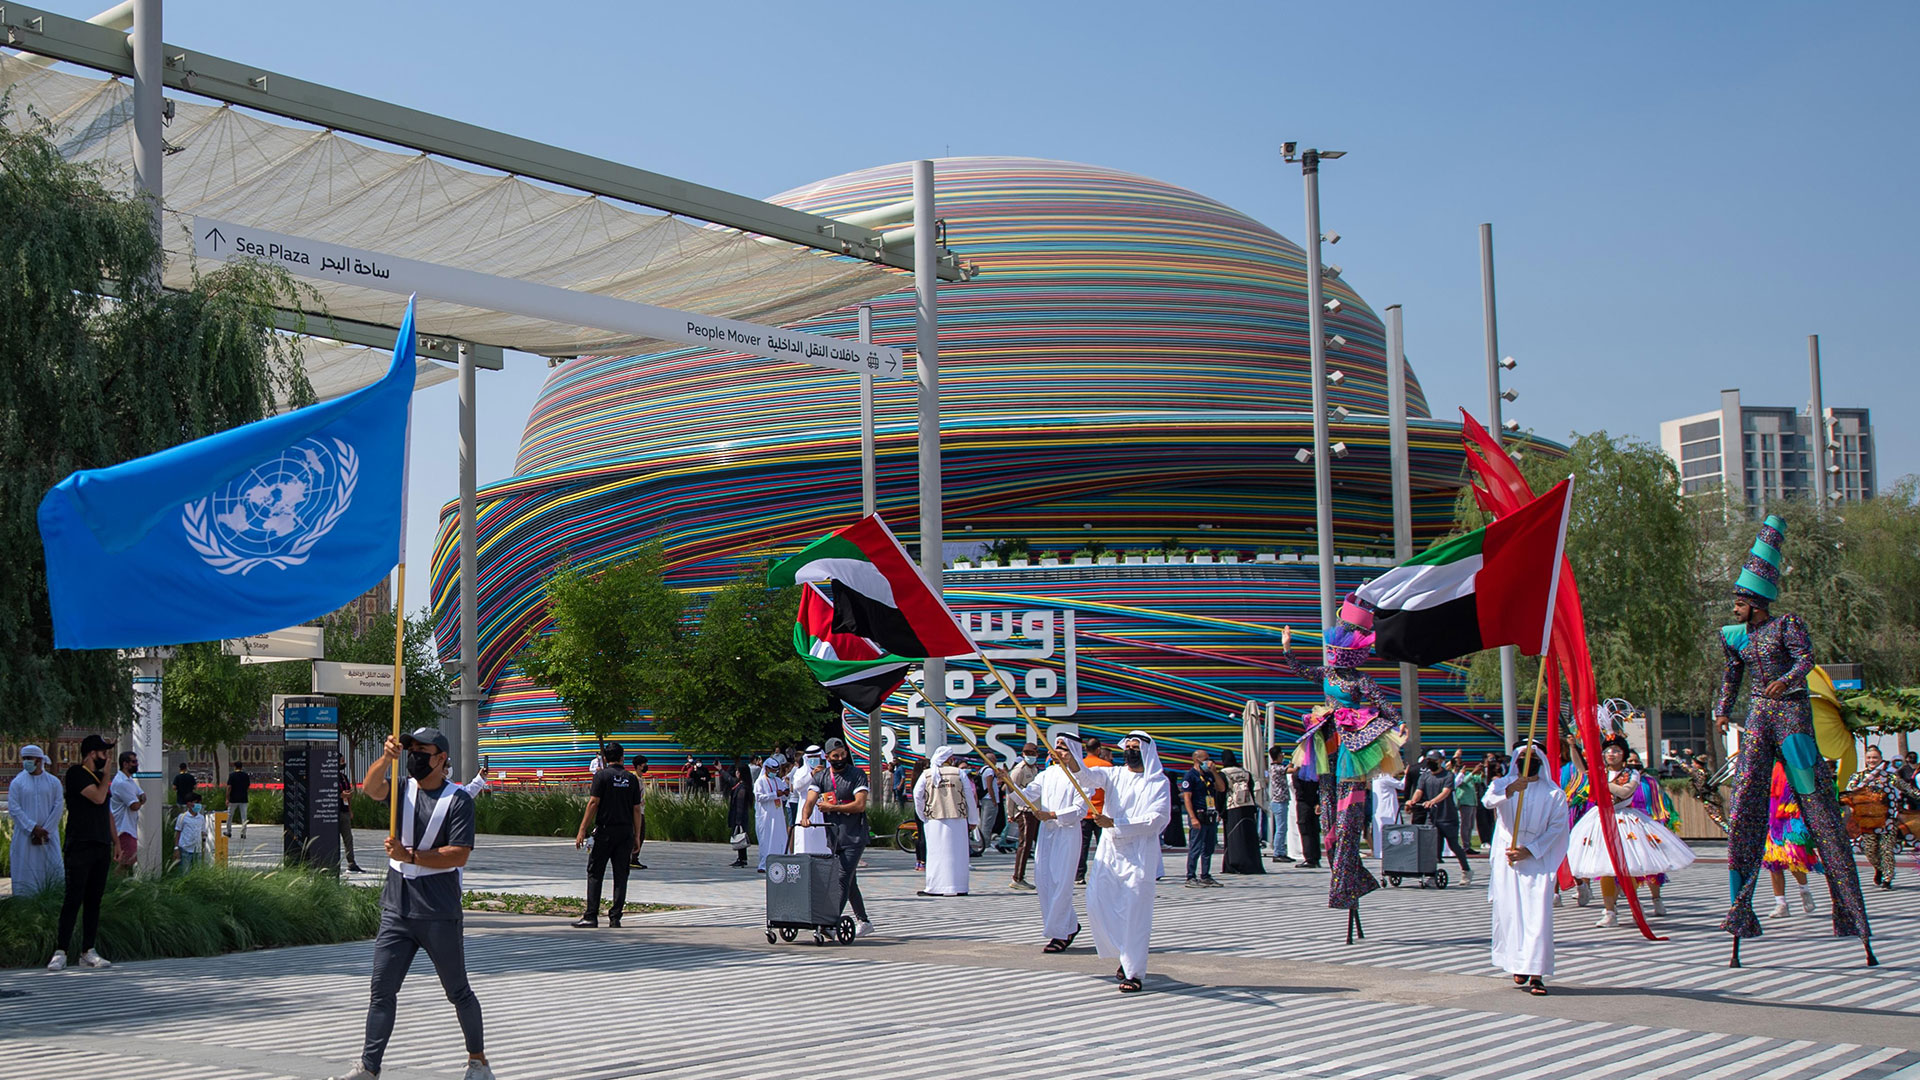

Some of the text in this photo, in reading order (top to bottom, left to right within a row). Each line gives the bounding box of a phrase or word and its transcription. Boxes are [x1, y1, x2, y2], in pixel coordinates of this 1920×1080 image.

[236, 237, 310, 265] Sea Plaza
[320, 256, 390, 279] ساحة البحر
[687, 322, 761, 346] People Mover
[767, 335, 861, 363] حافلات النقل الداخلية
[253, 641, 269, 650] Stage
[144, 720, 152, 747] Horizon
